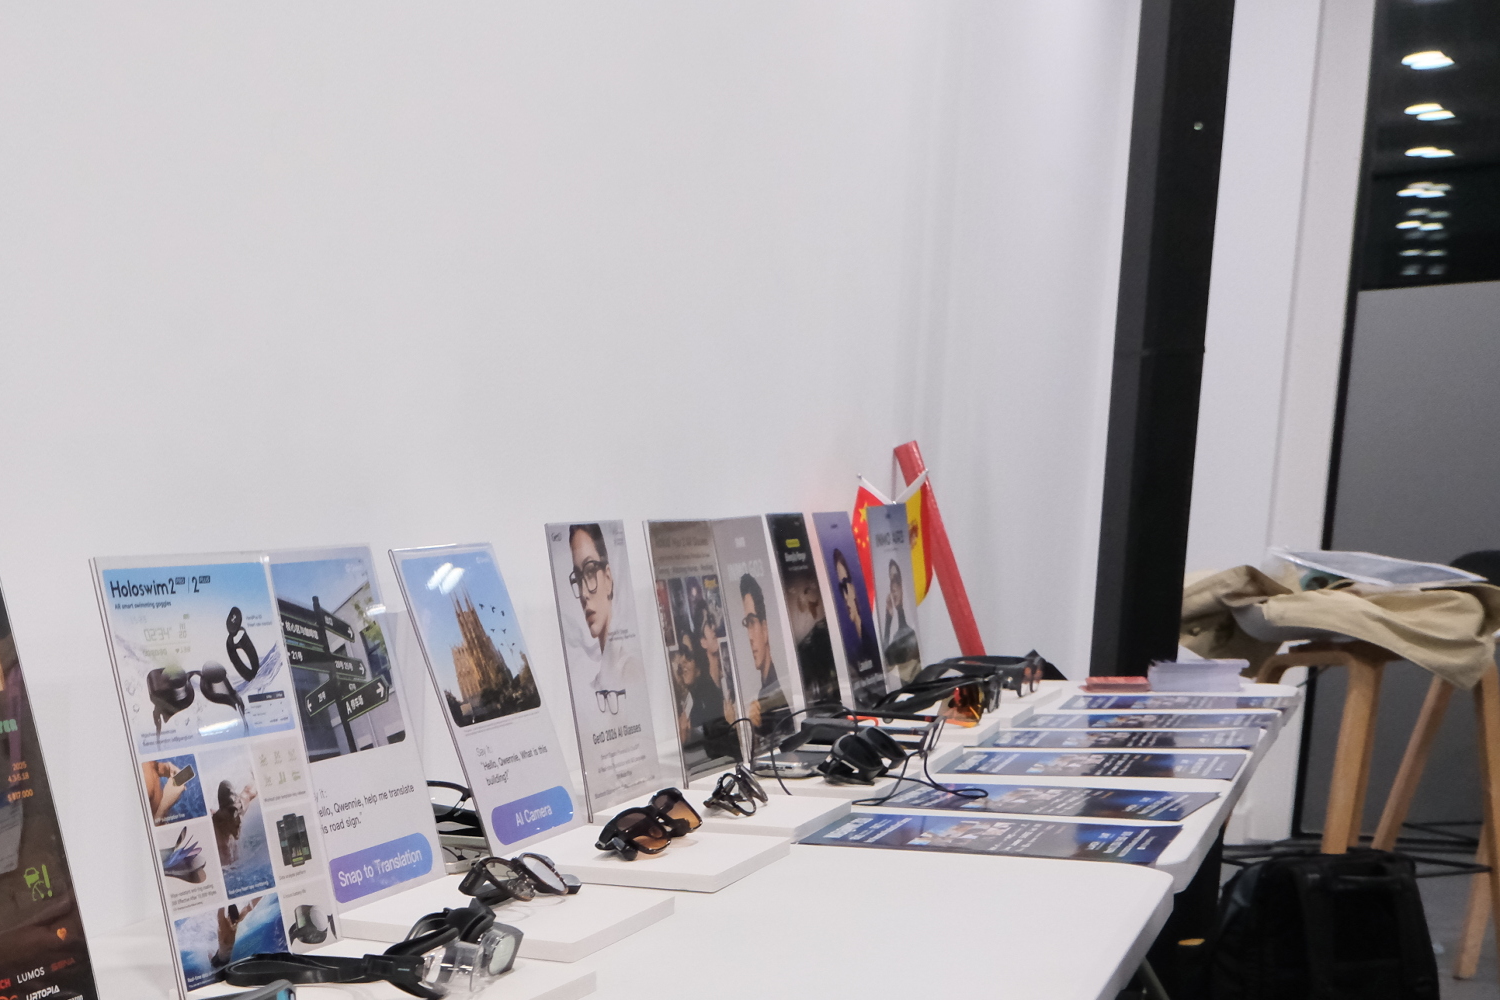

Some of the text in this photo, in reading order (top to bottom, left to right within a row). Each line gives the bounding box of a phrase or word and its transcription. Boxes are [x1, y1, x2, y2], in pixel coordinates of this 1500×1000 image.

[192, 576, 199, 593] 2
[623, 724, 642, 736] Glasses
[317, 784, 414, 817] ello, Qwennie, help me translate
[515, 805, 553, 827] AI Camera
[329, 820, 344, 833] road
[338, 849, 422, 887] Snap to Translation
[16, 966, 45, 984] LUMOS
